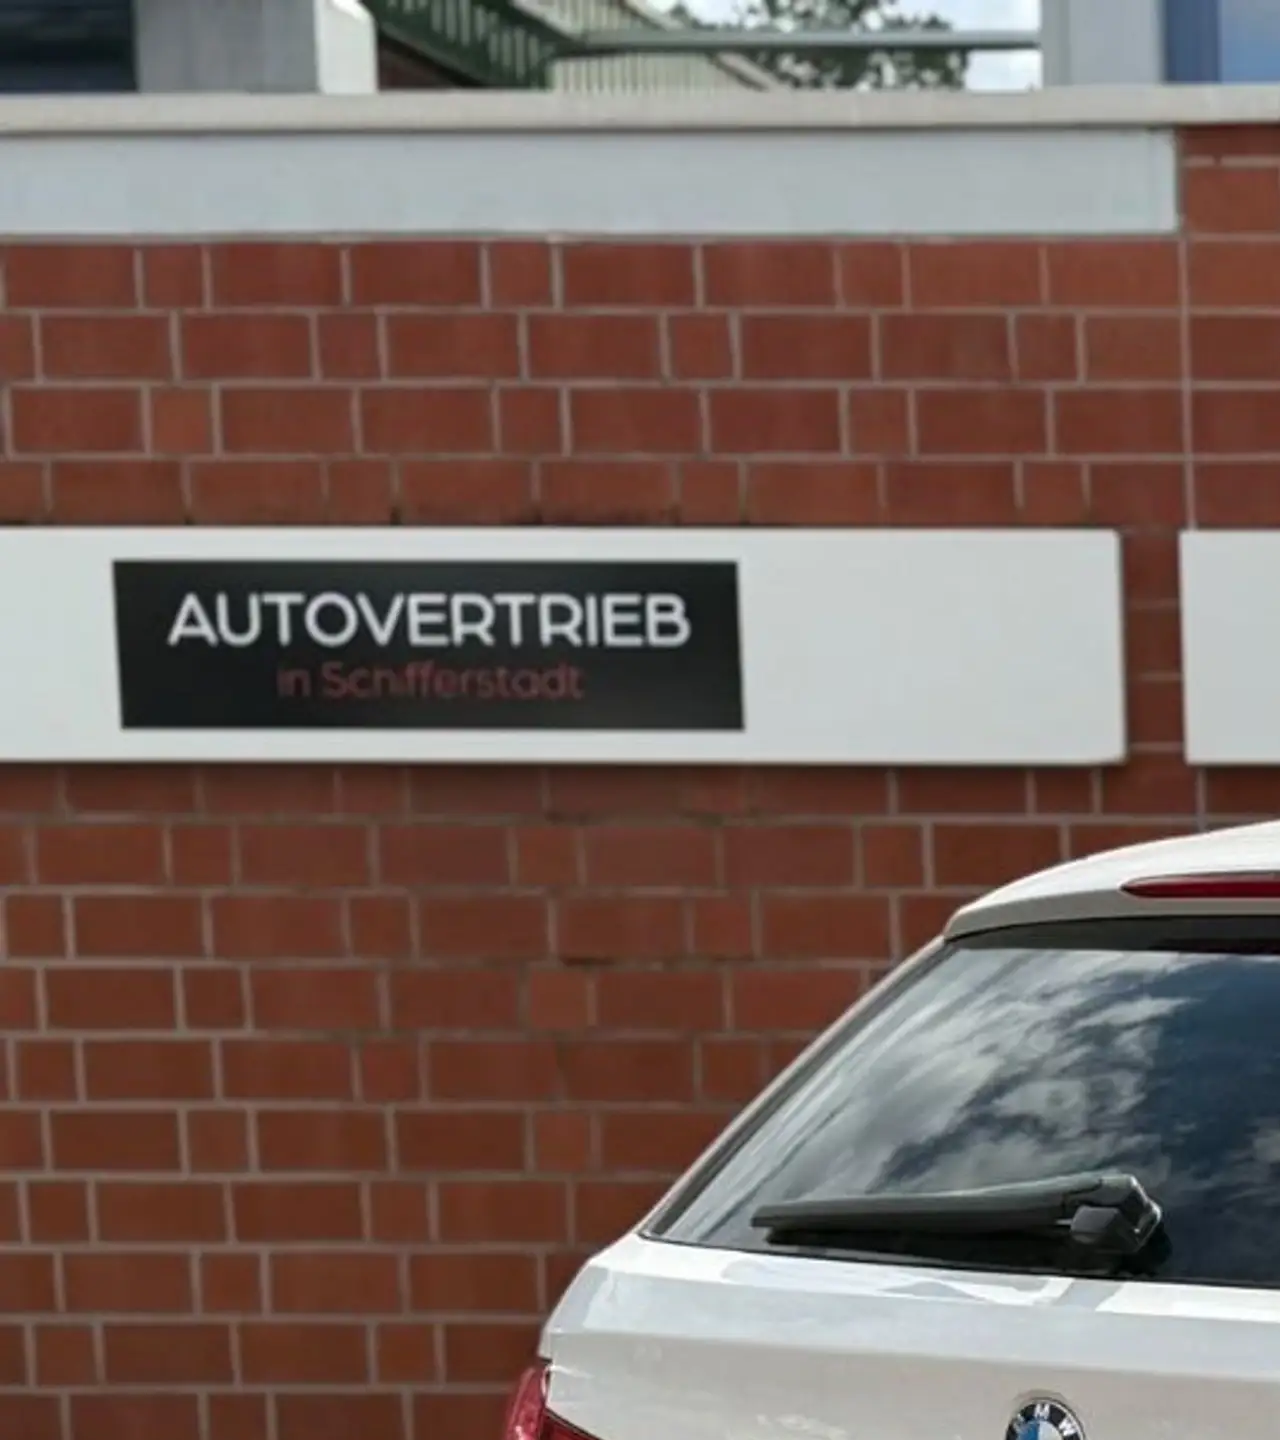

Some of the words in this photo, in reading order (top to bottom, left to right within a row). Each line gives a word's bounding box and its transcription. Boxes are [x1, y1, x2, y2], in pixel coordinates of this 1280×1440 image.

[167, 592, 692, 647] AUTOVERTRIEB
[276, 662, 311, 698] in
[321, 659, 584, 699] Schifferstadt
